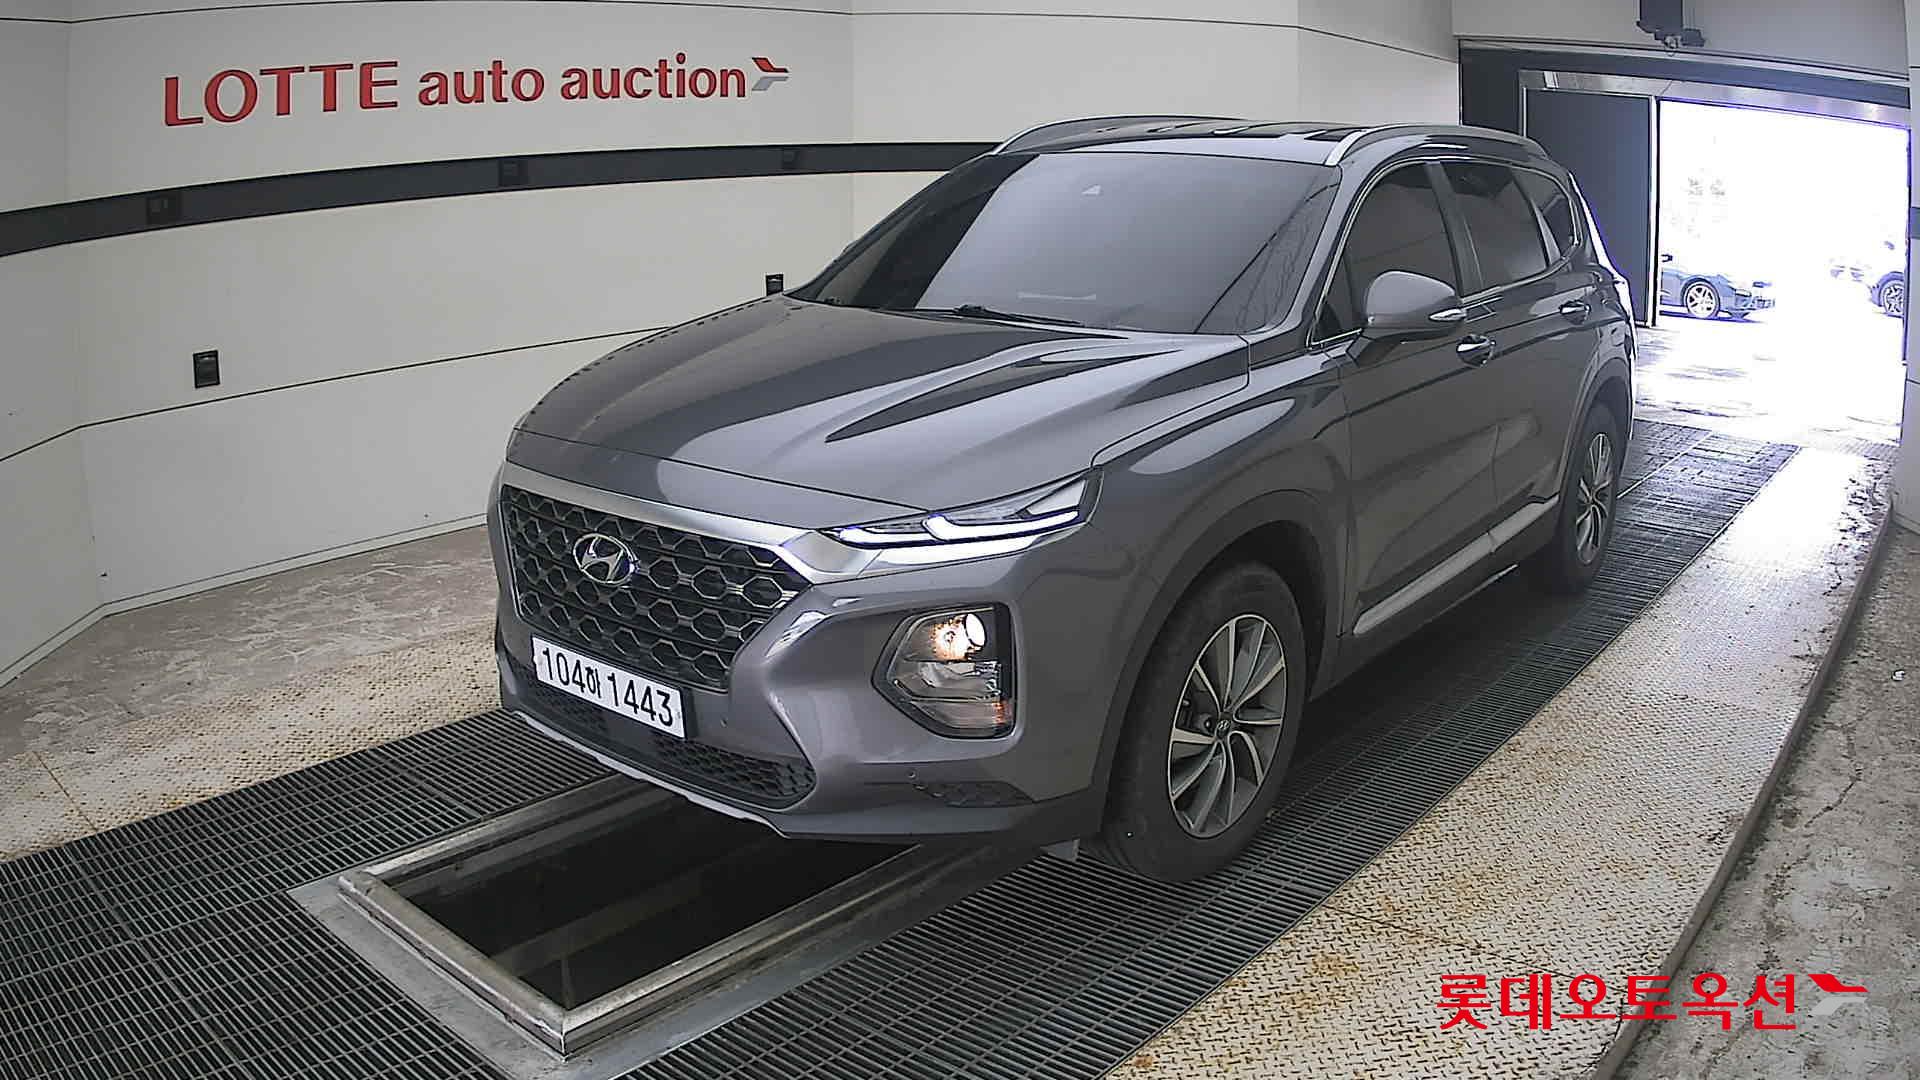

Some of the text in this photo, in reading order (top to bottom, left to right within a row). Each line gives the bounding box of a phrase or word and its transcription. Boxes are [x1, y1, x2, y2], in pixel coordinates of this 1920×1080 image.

[164, 52, 746, 126] LOTTE auto auction
